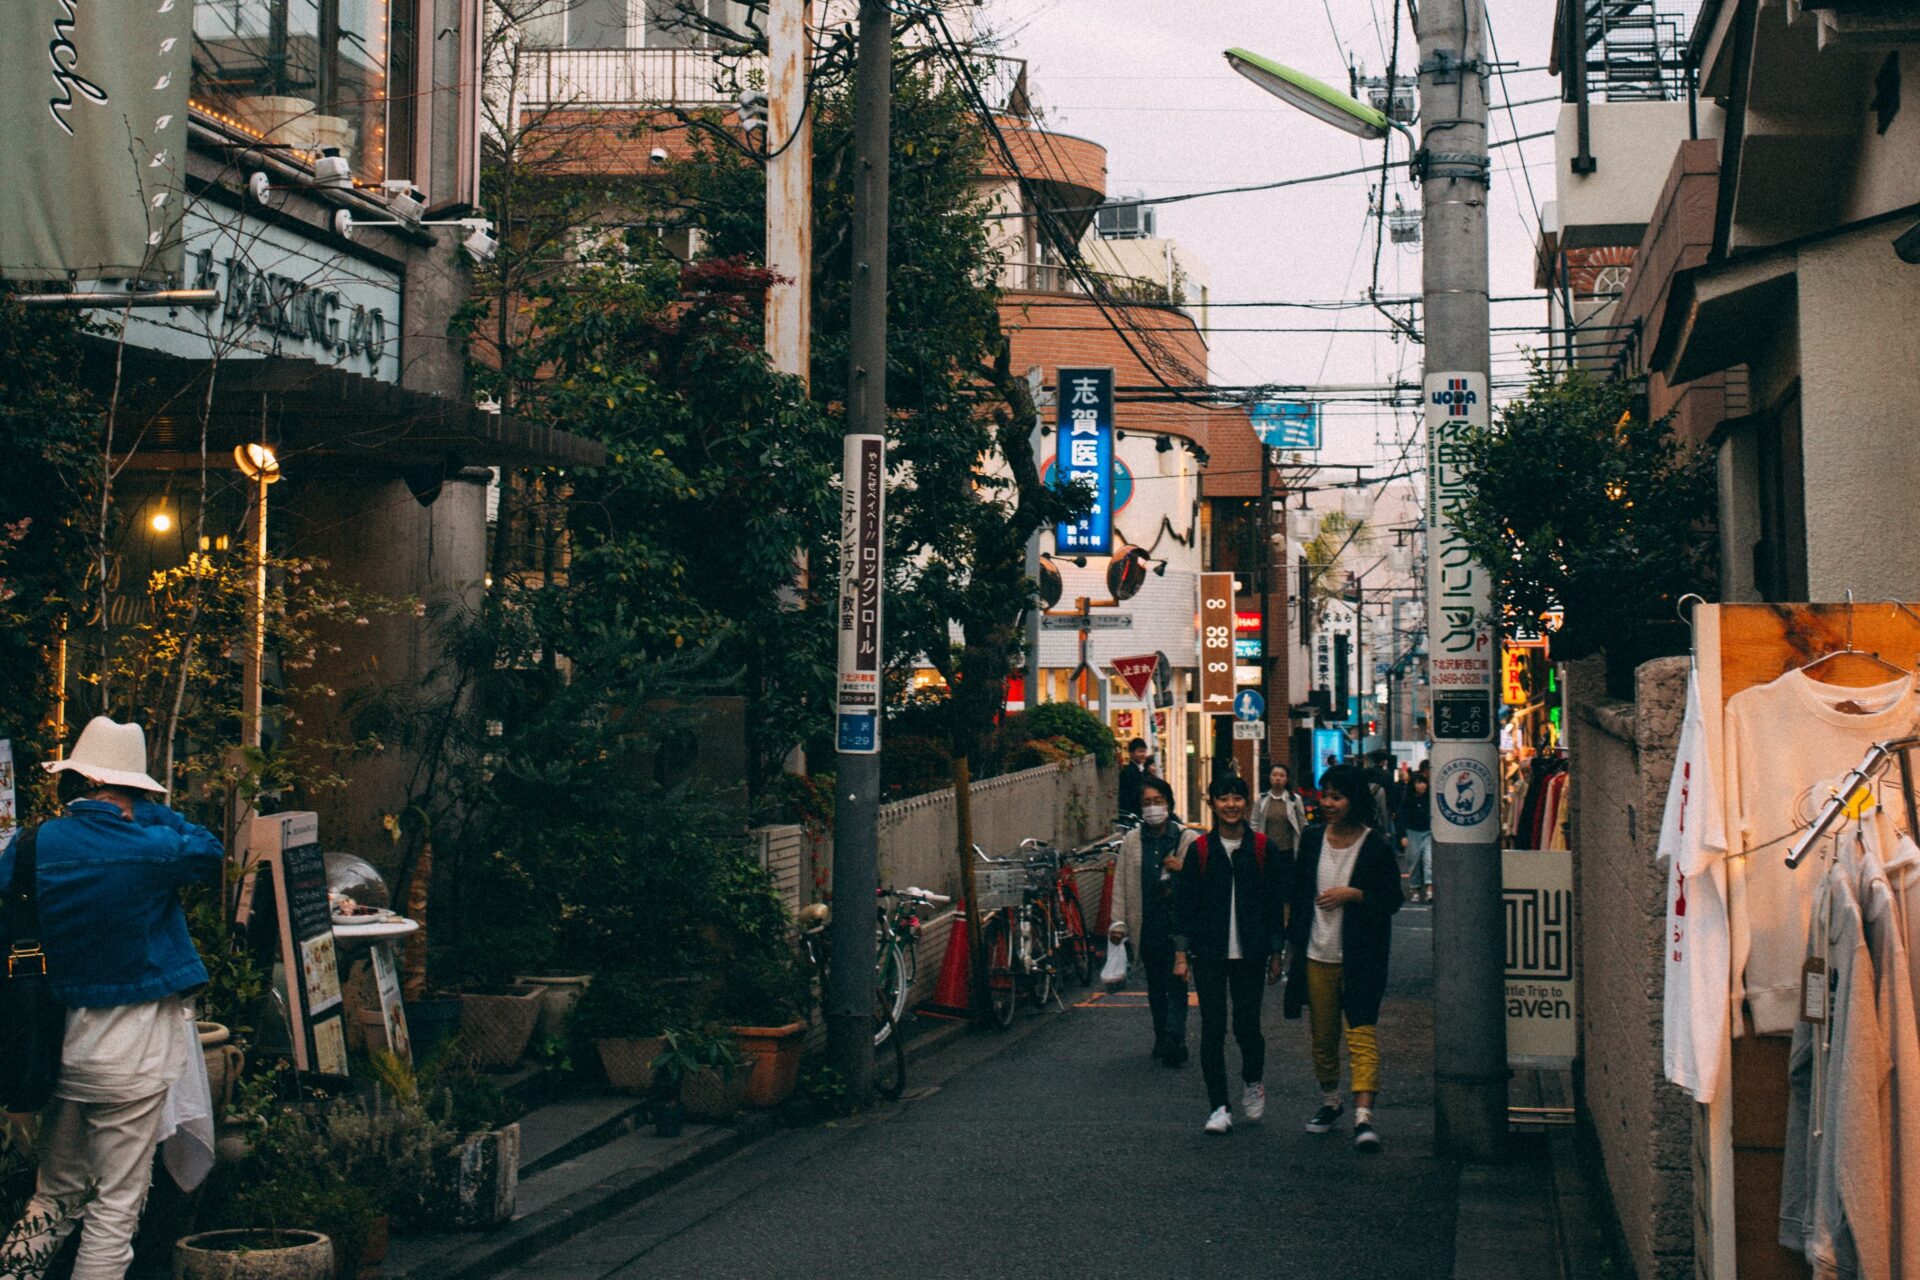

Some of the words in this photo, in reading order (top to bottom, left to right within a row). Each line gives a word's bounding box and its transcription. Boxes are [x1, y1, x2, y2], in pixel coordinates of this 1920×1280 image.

[842, 490, 857, 630] ミオンギター教室
[859, 547, 877, 654] ロックンロール
[1238, 617, 1260, 627] HAIR
[1123, 664, 1151, 677] 止まれ
[1440, 721, 1481, 733] 2-26
[1527, 985, 1549, 998] Trip
[1551, 987, 1563, 997] to
